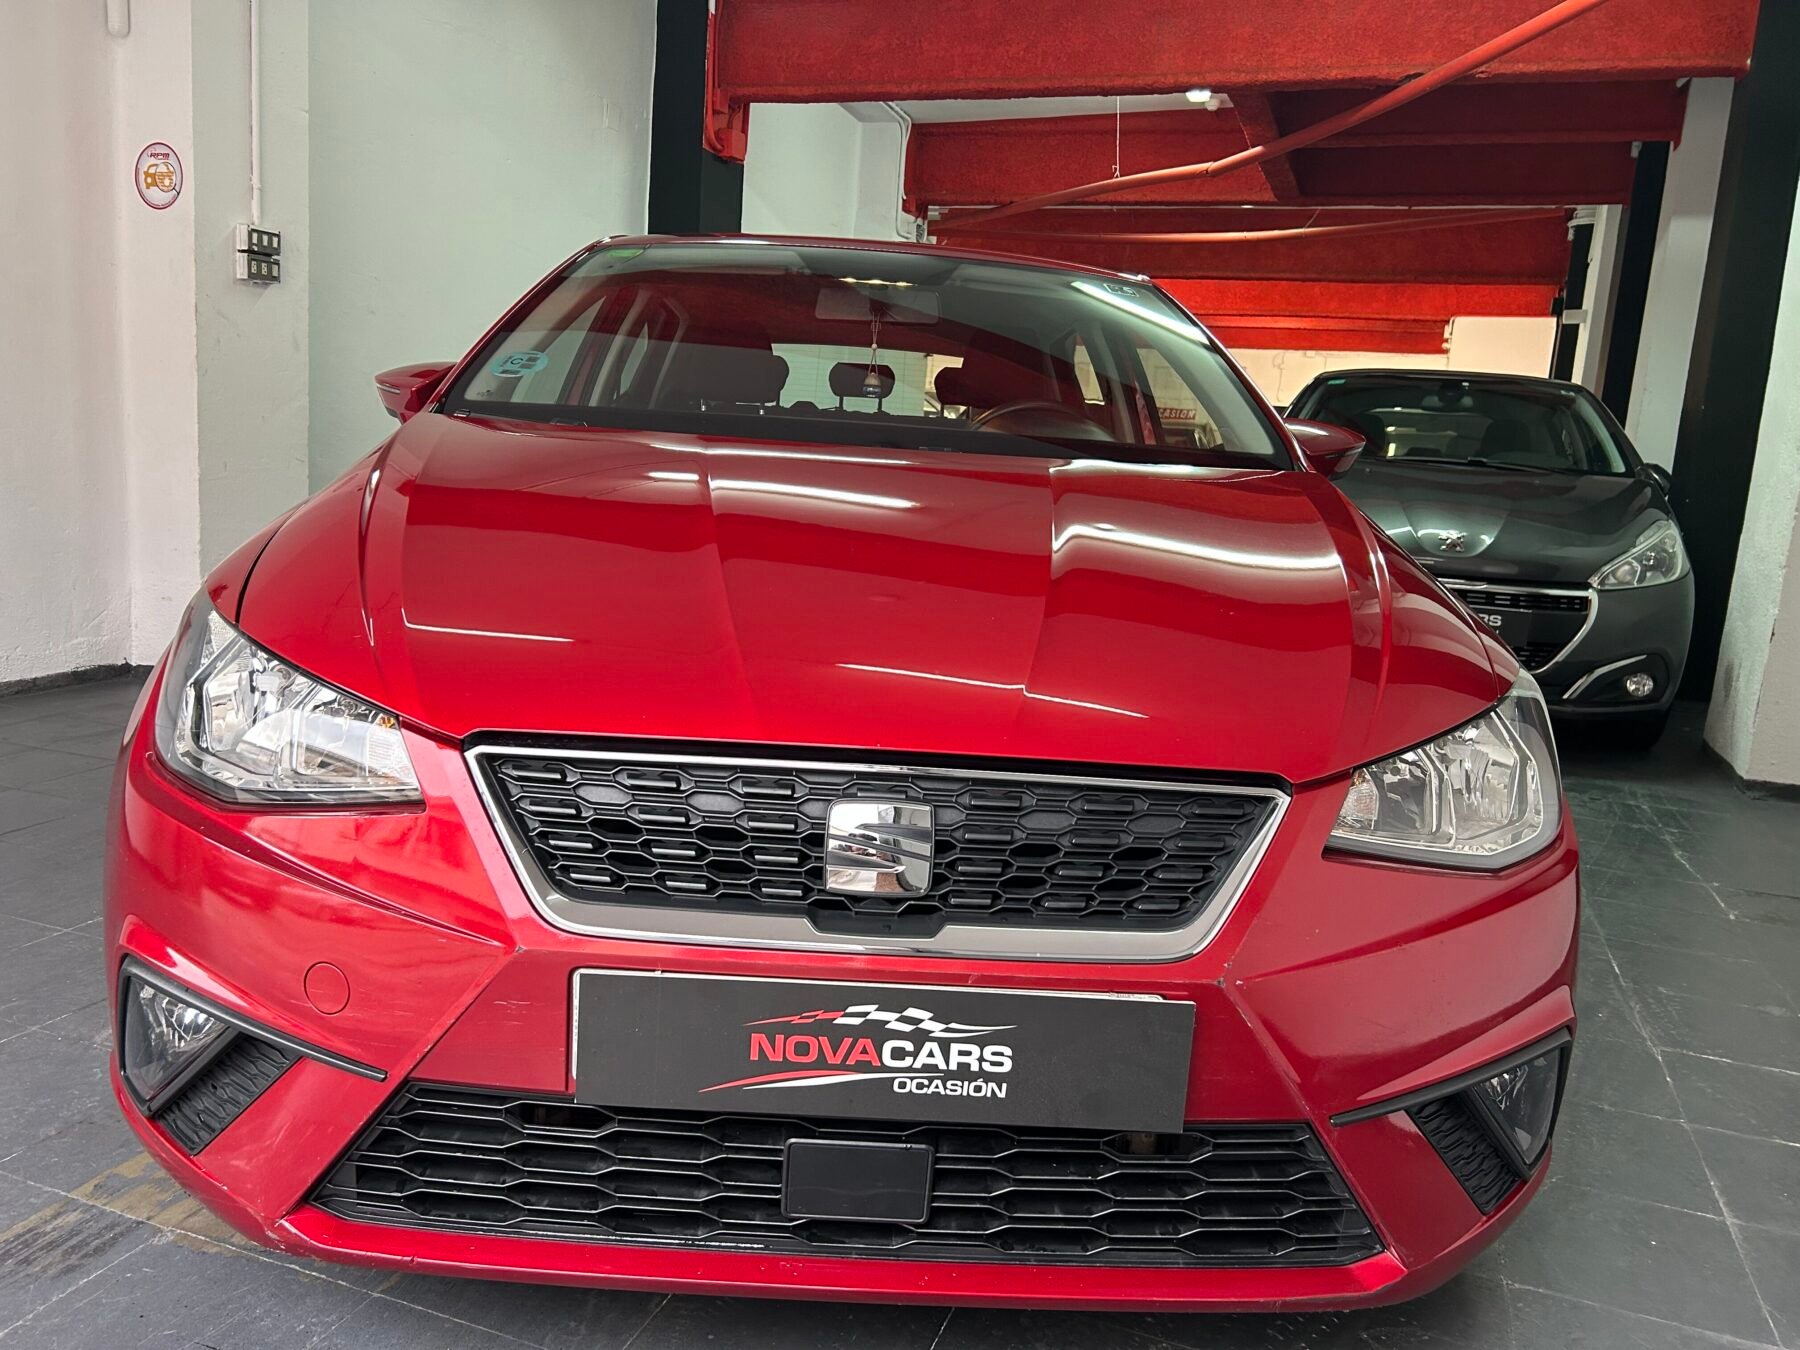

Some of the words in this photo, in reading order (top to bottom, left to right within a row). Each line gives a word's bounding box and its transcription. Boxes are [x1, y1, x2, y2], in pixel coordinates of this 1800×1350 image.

[1158, 408, 1195, 418] CASION
[750, 1033, 1012, 1073] NOVACARS
[893, 1078, 1007, 1098] OCASIÓN
